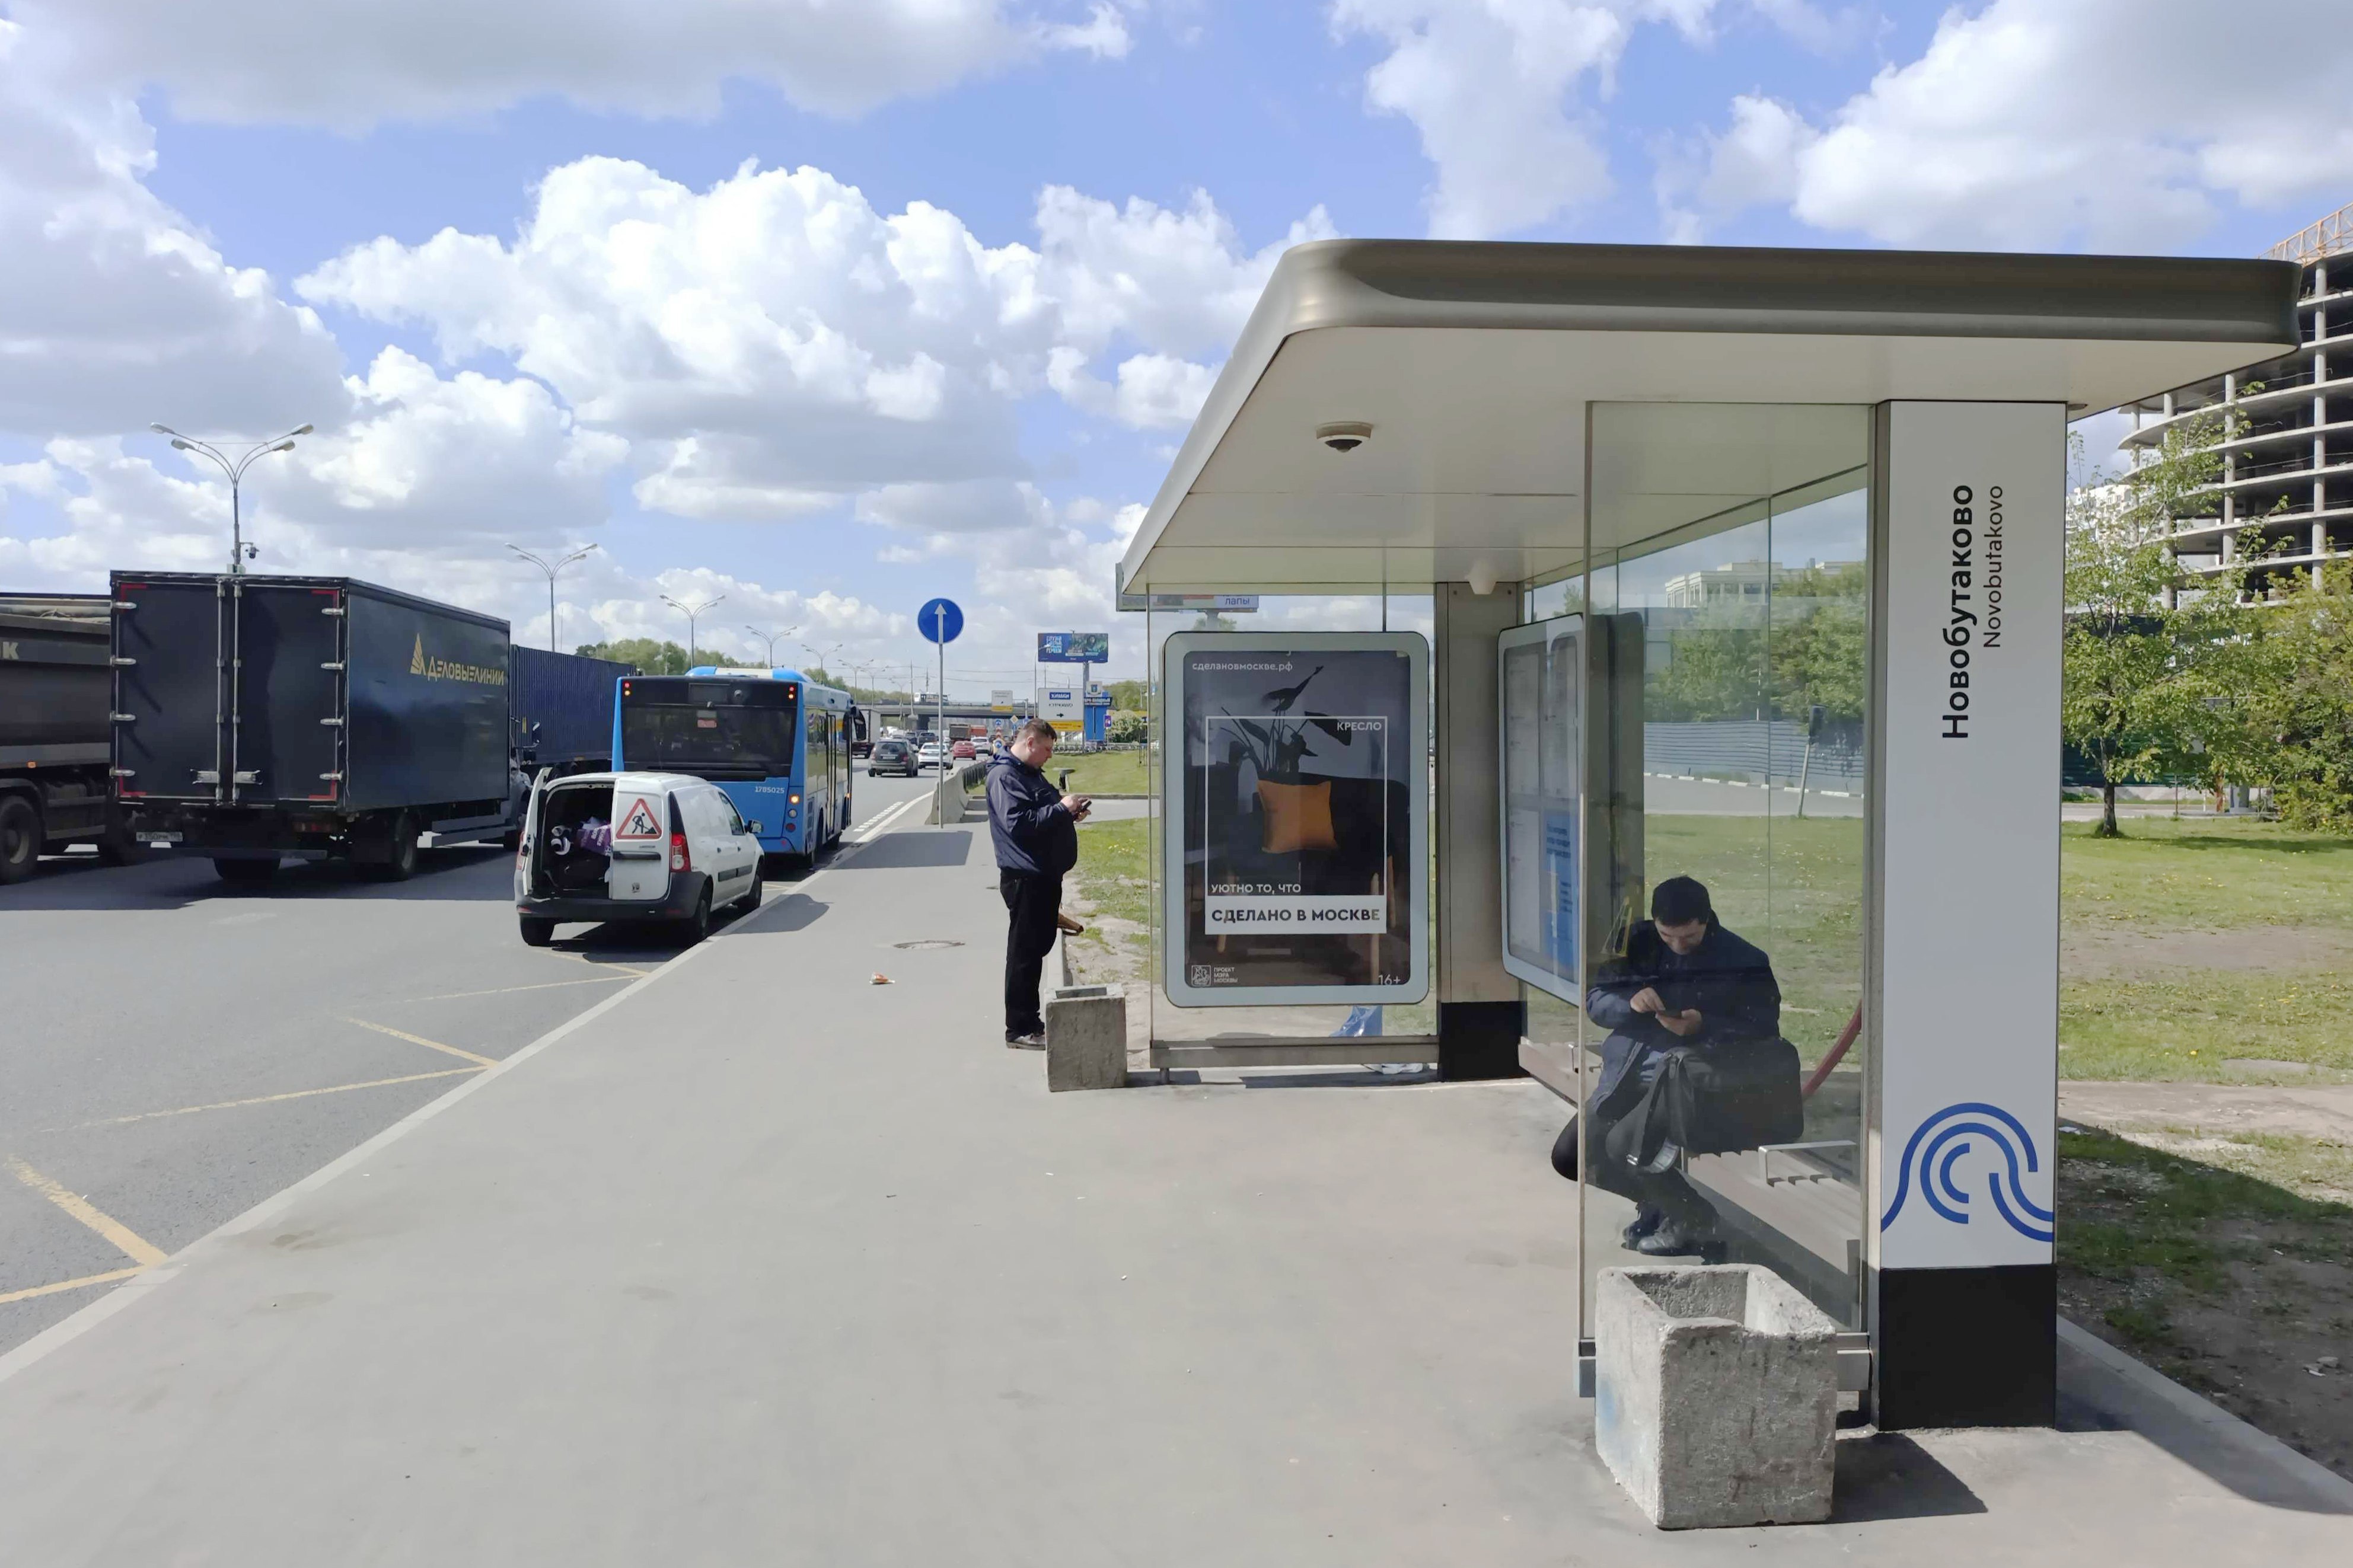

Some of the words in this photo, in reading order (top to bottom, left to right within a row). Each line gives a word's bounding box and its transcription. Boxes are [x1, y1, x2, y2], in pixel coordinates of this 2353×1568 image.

[1983, 486, 2003, 648] Novobutakovo
[1942, 485, 1977, 739] Новобутаково
[1192, 661, 1293, 672] сделановмоскве.рф
[1337, 721, 1382, 732] КРЕСЛО
[1211, 884, 1254, 893] УЮТНО
[1257, 884, 1275, 895] ТО,
[1278, 884, 1302, 893] ЧТО
[1211, 909, 1292, 923] СДЕЛАНО
[1297, 909, 1307, 921] В
[1312, 909, 1380, 921] МОСКВЕ
[1379, 974, 1401, 985] 16+
